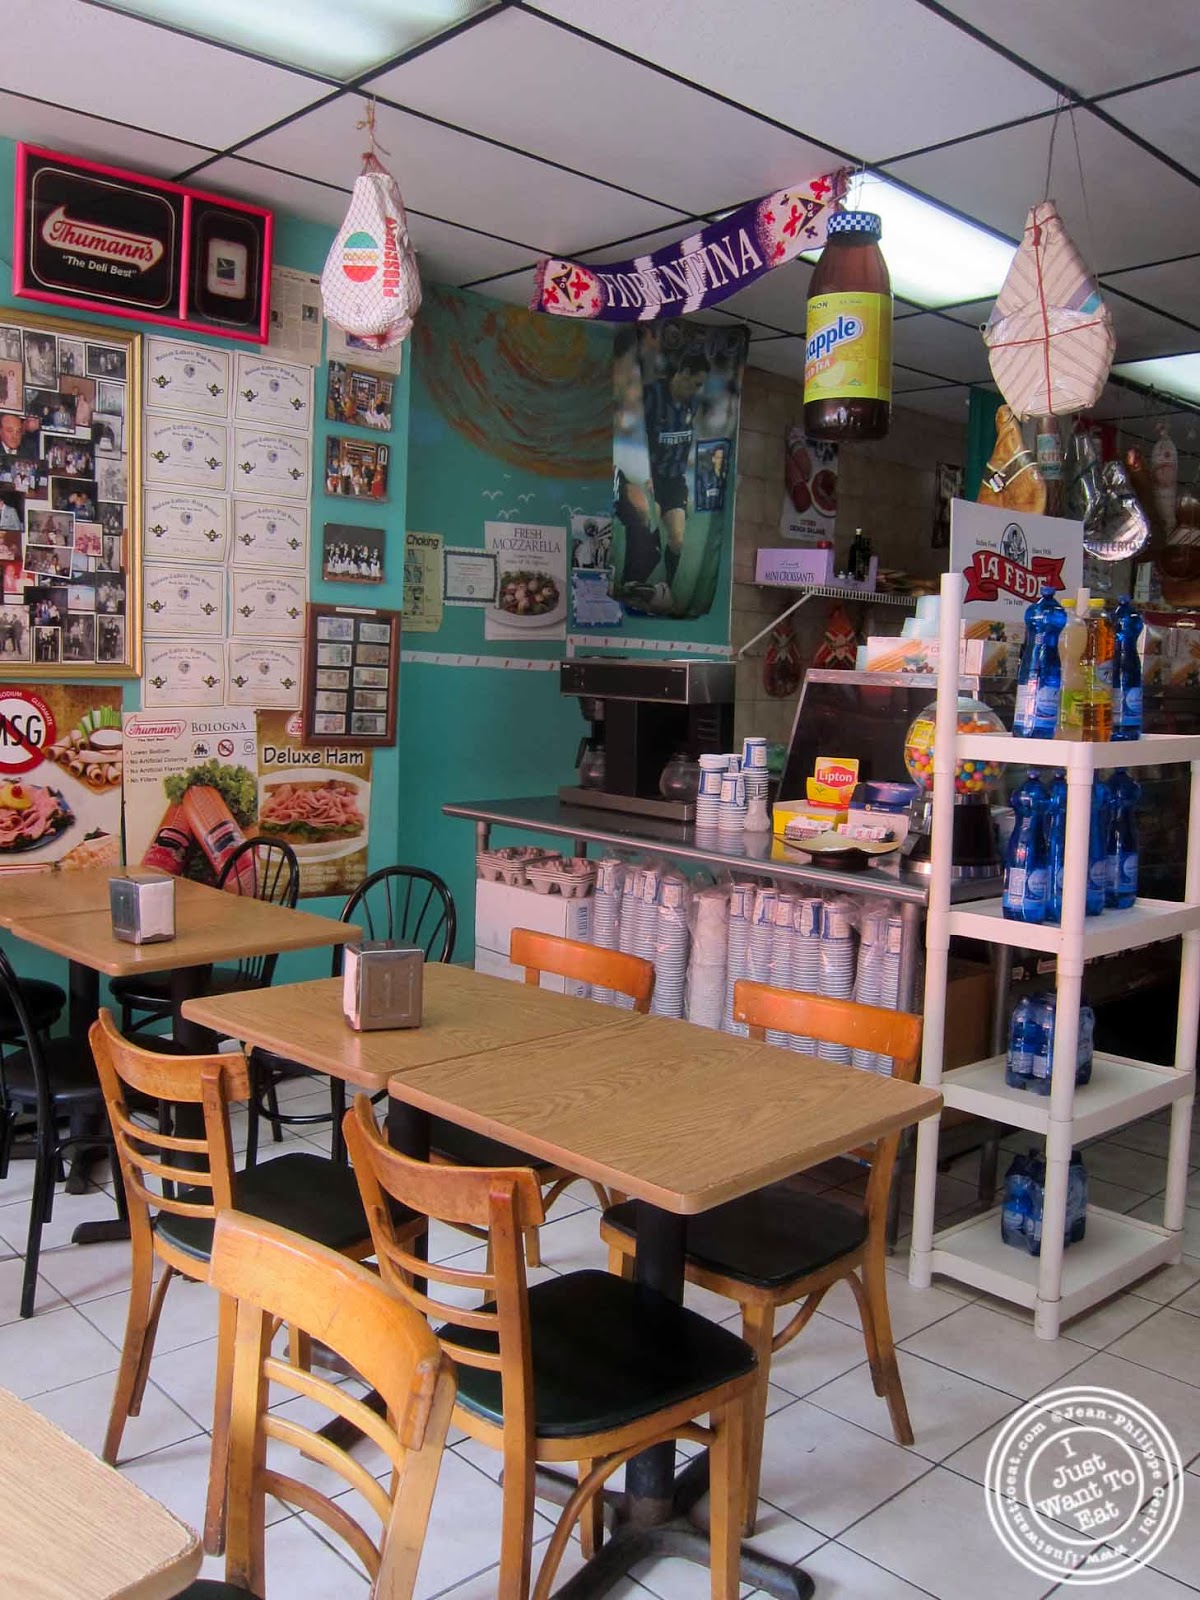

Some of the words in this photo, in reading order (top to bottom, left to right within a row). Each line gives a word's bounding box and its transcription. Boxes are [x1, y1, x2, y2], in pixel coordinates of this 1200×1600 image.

[49, 219, 155, 262] Thumann's
[63, 254, 86, 269] "The
[88, 259, 108, 273] Deli
[110, 264, 137, 278] Best"
[600, 228, 764, 308] FIORENTINA
[513, 528, 542, 539] FRESH
[406, 534, 439, 550] Choking
[492, 538, 561, 554] MOZZARELLA
[979, 554, 999, 581] LA
[191, 721, 247, 733] BOLOGNA
[263, 747, 321, 764] Deluxe
[326, 750, 364, 764] Ham
[819, 770, 853, 783] Lipton
